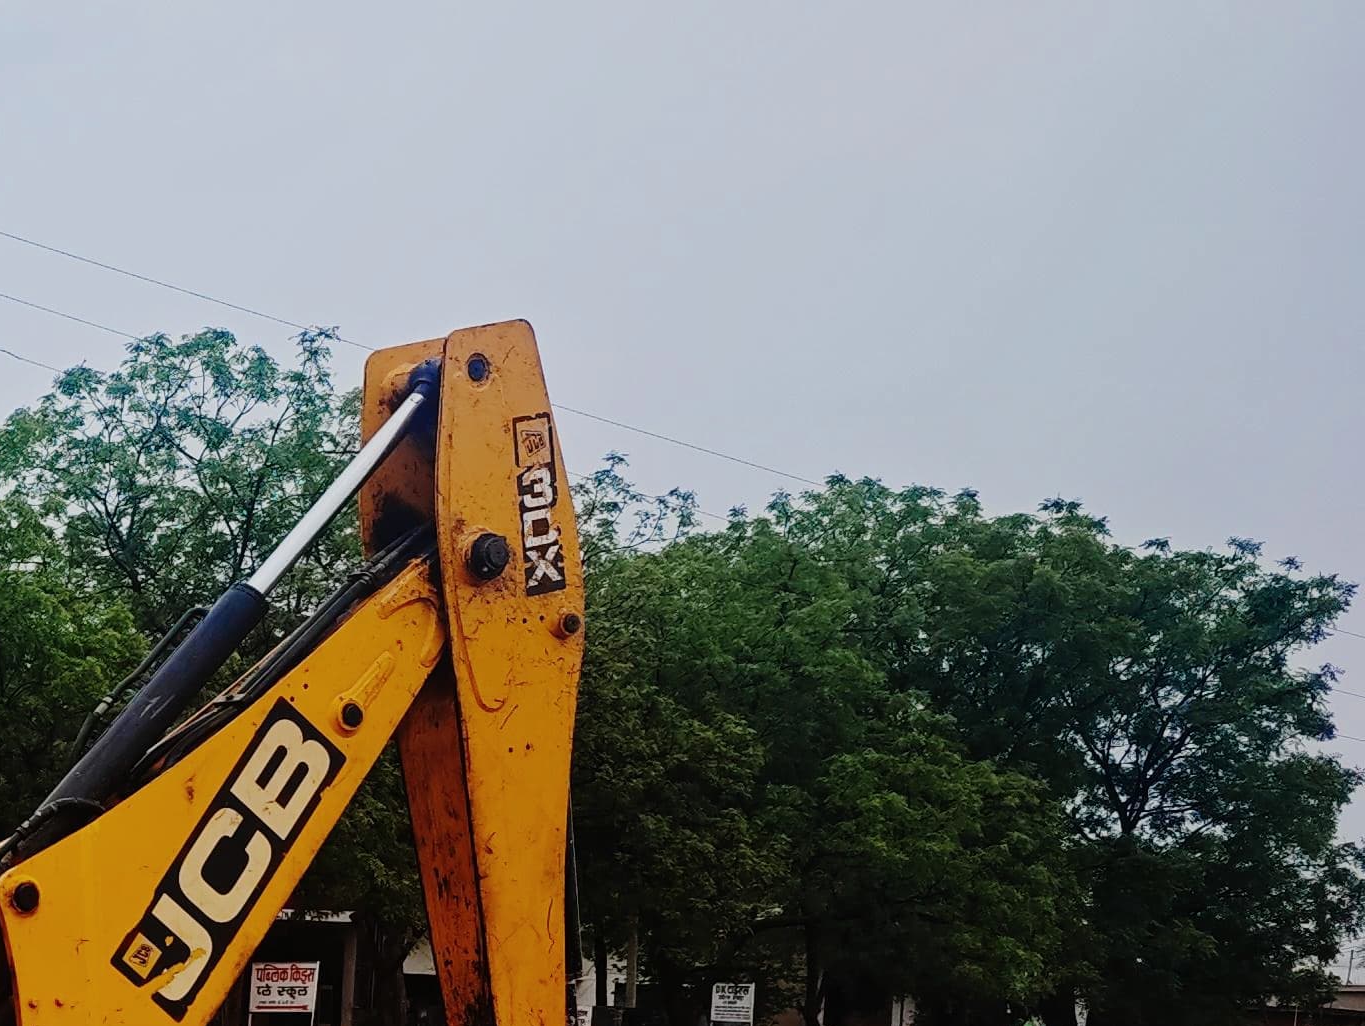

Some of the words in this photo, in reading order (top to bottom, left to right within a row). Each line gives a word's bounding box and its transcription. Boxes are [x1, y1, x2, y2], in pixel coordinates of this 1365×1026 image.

[521, 466, 564, 588] 3DX
[152, 718, 331, 1001] JCB
[133, 944, 152, 965] JCB
[255, 963, 289, 983] पब्लिक
[277, 985, 310, 1000] स्कूल
